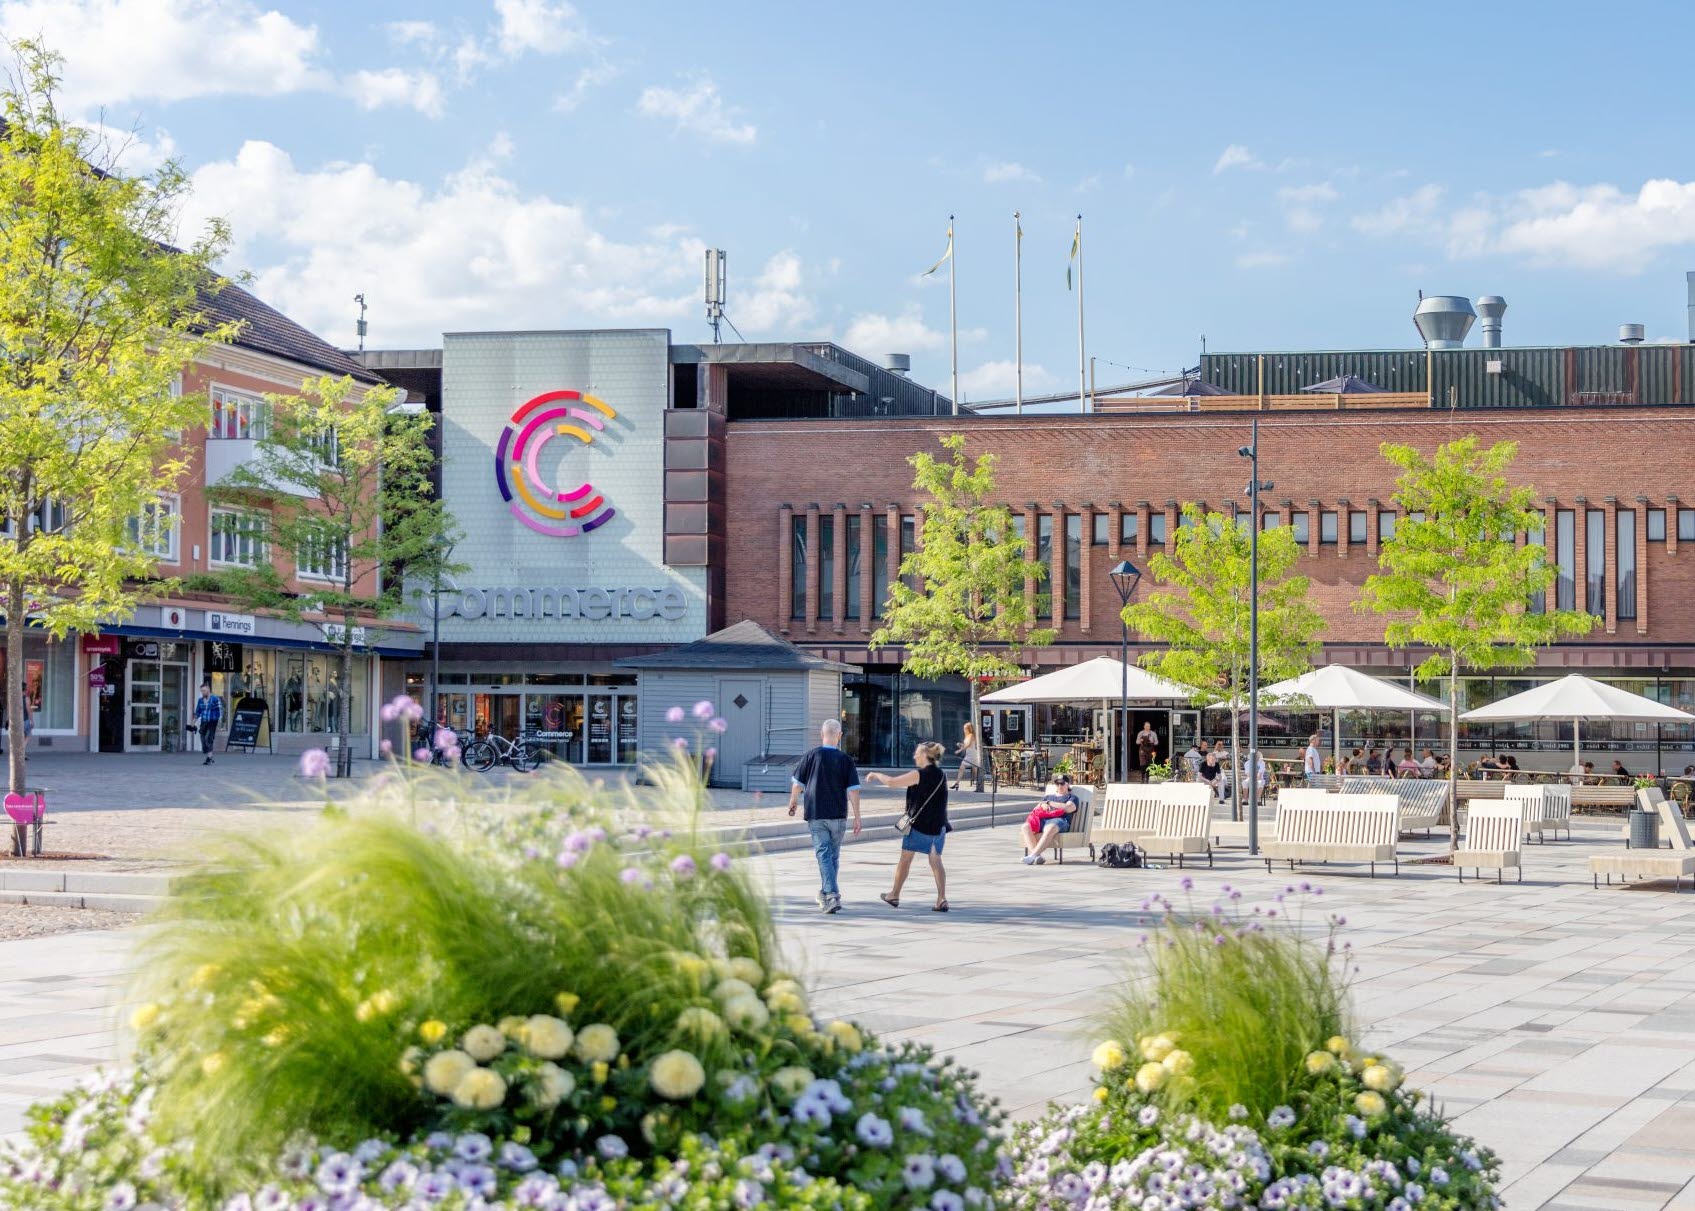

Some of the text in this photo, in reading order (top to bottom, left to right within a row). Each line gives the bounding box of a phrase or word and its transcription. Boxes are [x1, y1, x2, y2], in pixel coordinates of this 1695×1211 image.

[420, 577, 688, 621] Commerce
[222, 614, 252, 633] Hennings
[536, 730, 573, 738] Commerce
